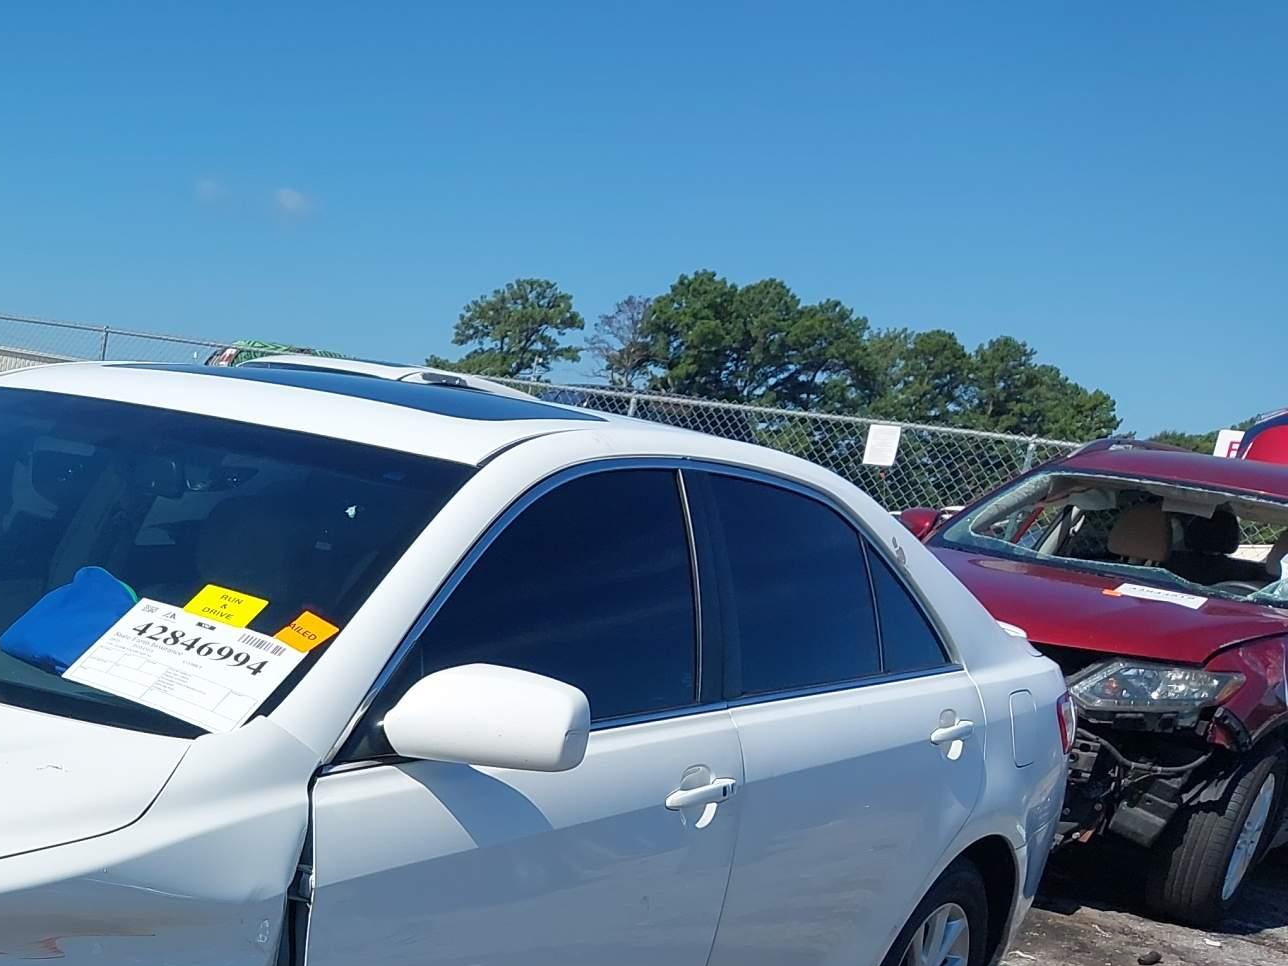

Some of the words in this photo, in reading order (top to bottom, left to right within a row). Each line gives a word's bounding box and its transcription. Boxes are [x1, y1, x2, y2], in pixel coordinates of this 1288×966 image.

[220, 593, 245, 606] RUN
[201, 606, 235, 621] DRIVE
[132, 621, 270, 677] 42846994
